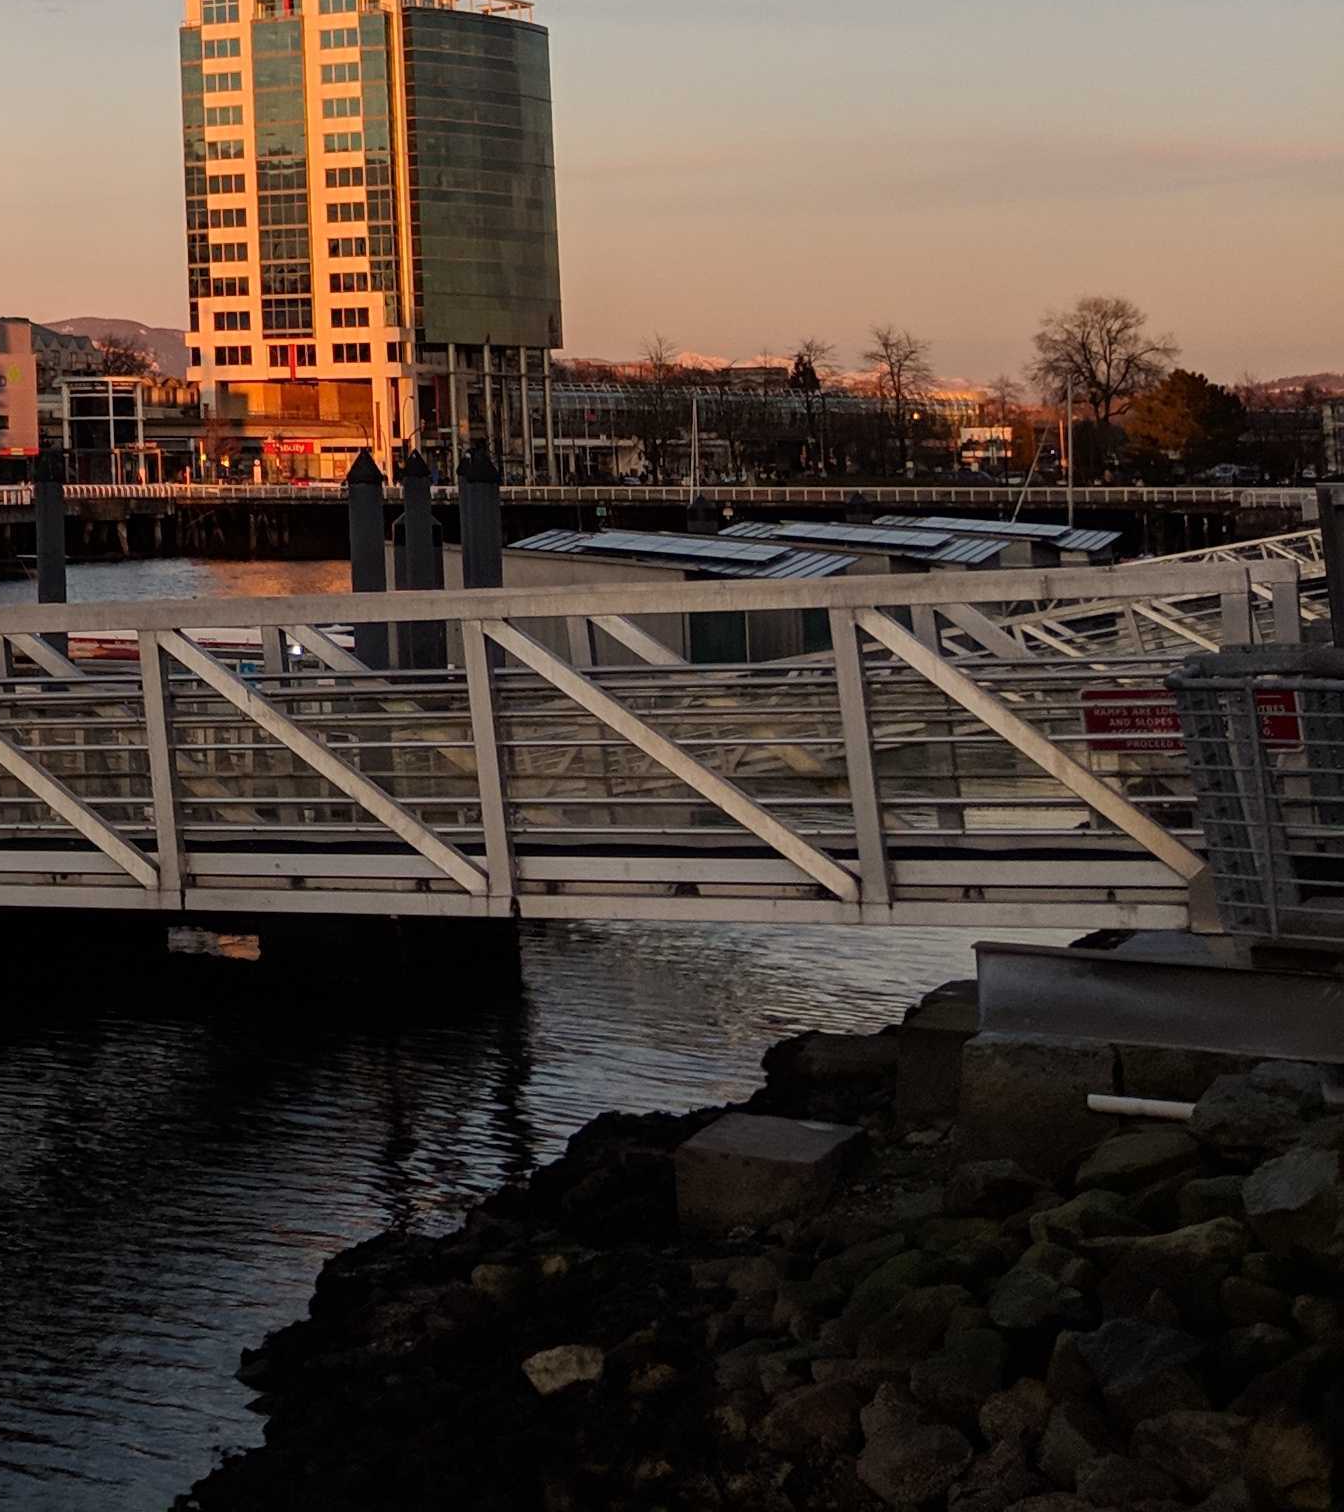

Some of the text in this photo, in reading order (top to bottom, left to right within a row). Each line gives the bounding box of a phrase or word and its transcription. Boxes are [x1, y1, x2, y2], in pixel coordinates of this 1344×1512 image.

[1132, 707, 1153, 716] ARE
[1109, 717, 1174, 727] AND SLOPES
